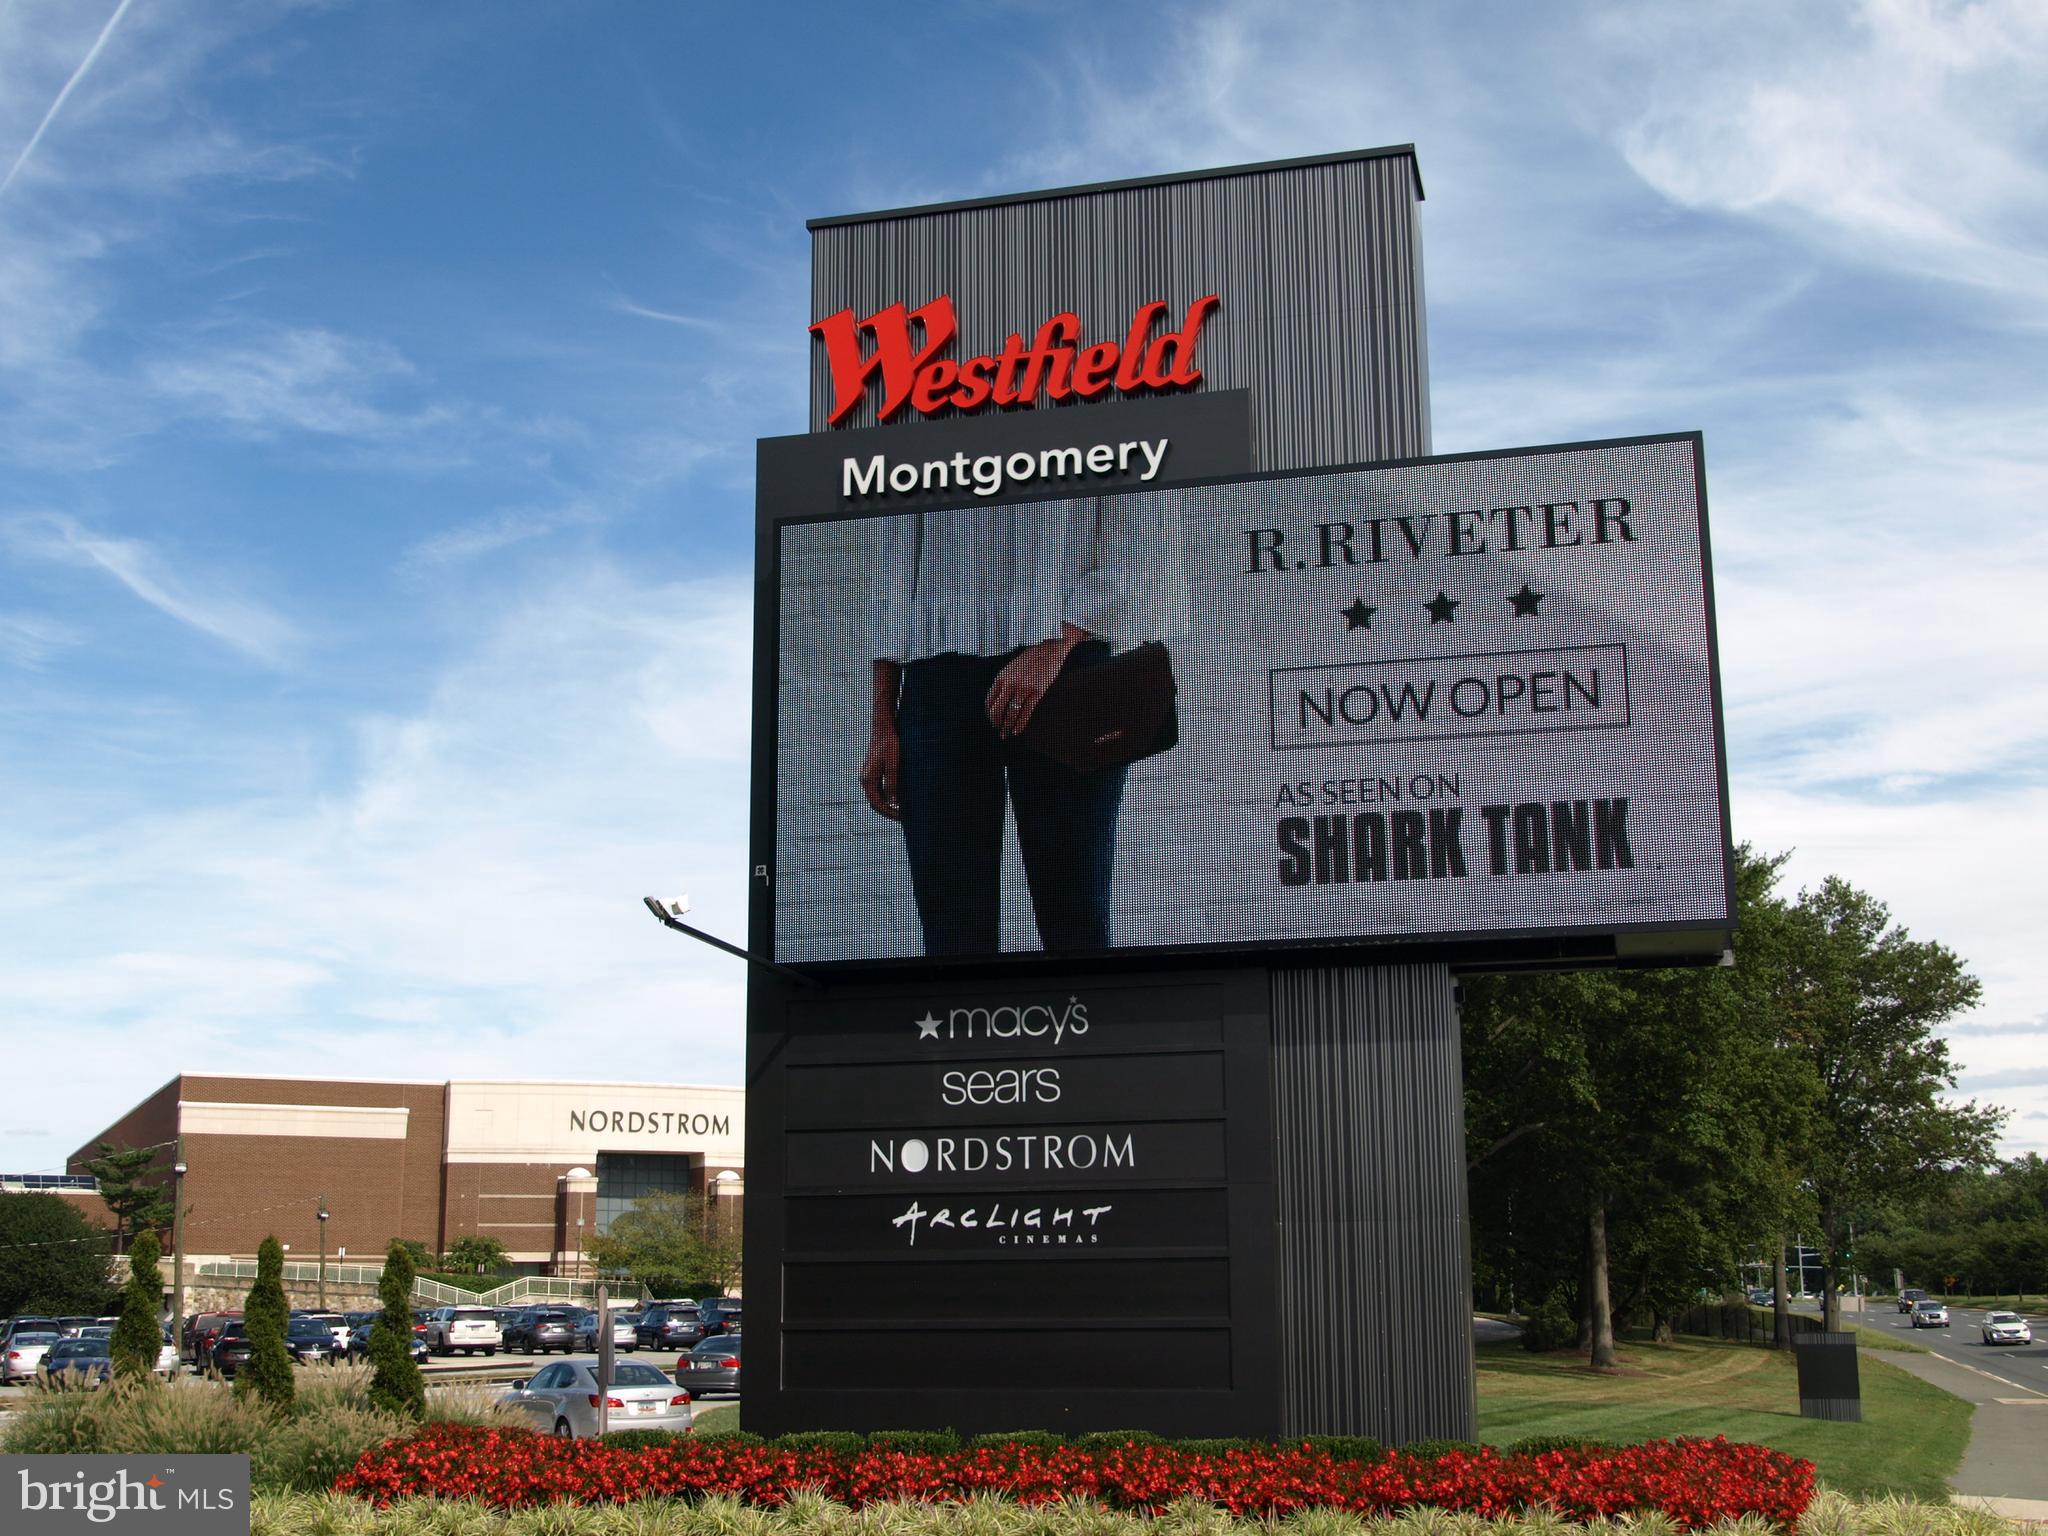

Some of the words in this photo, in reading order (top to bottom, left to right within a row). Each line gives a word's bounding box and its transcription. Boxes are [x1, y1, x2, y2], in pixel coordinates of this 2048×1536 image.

[809, 294, 1219, 425] Westfield
[842, 438, 1169, 497] Montgomery
[1300, 680, 1436, 728] NOW
[1450, 669, 1600, 718] OPEN
[1276, 783, 1312, 808] AS
[1322, 777, 1400, 804] SEEN
[1409, 773, 1460, 800] ON
[1276, 806, 1467, 887] SHARK
[1481, 798, 1635, 877] TANK
[942, 1068, 1061, 1105] sears
[570, 1109, 730, 1136] NORDSTROM
[871, 1133, 1135, 1173] NORDSTROM
[999, 1234, 1098, 1244] CINEMAS
